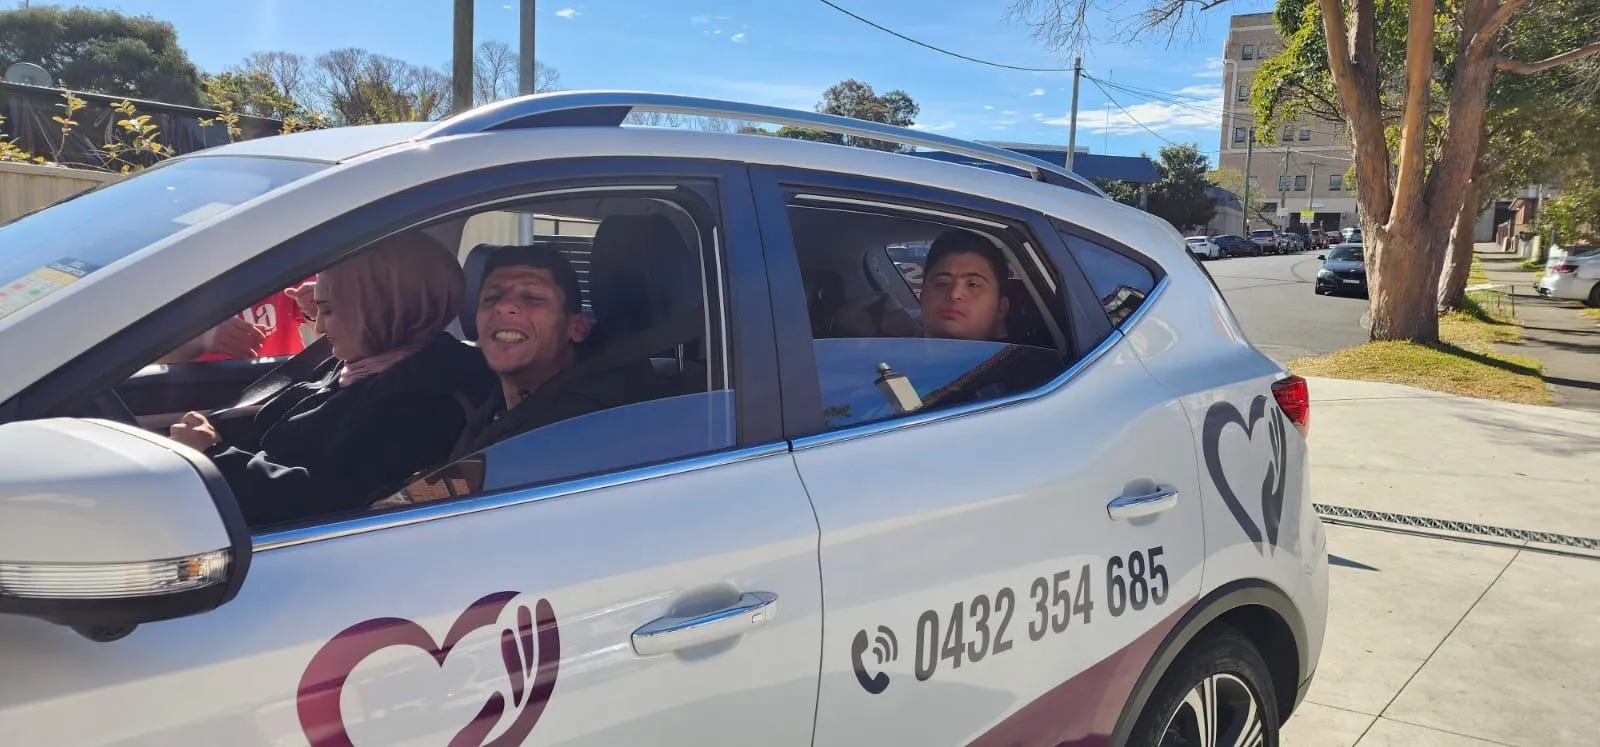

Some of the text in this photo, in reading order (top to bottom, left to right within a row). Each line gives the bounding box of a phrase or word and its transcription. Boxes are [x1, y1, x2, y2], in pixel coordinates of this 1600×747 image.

[914, 545, 1169, 682] 0432 354 685
